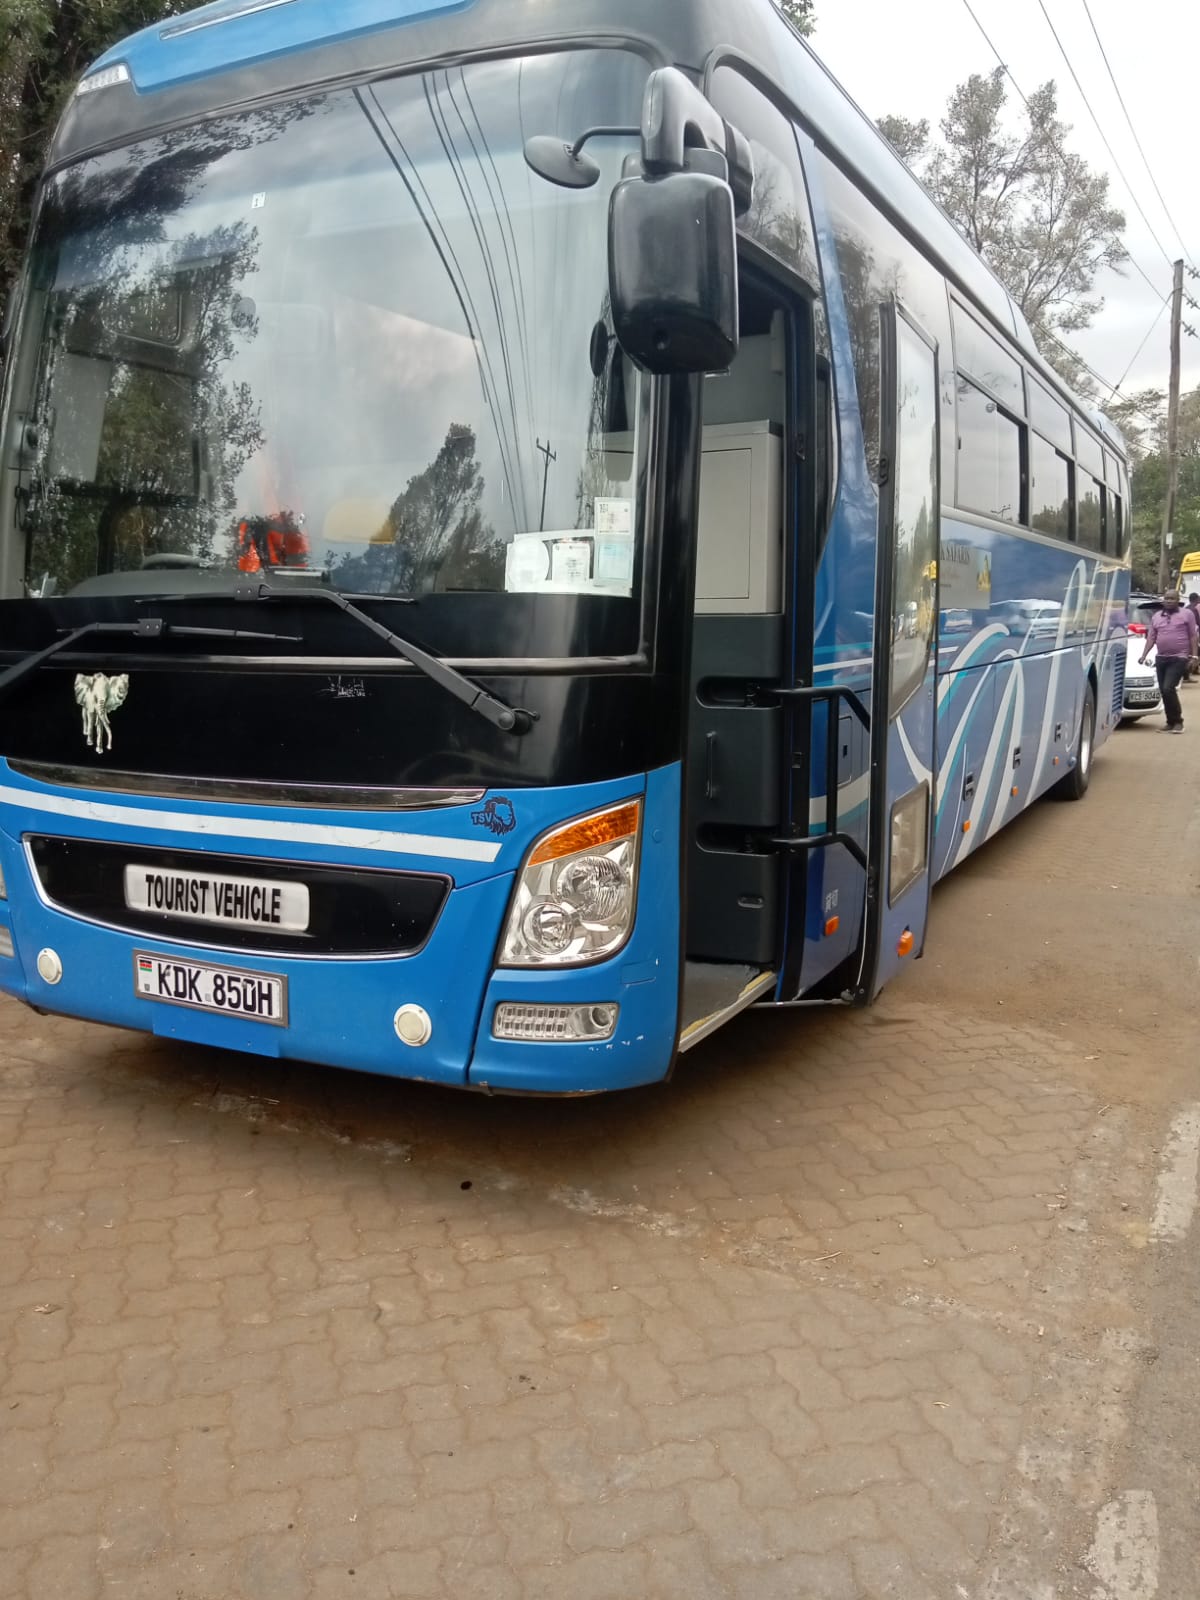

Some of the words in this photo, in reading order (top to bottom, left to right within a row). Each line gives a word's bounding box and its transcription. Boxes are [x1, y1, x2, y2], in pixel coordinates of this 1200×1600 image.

[145, 874, 209, 914] TOURIST
[213, 882, 281, 923] VEHICLE
[158, 963, 203, 1002] KDK
[213, 974, 273, 1015] 850H
